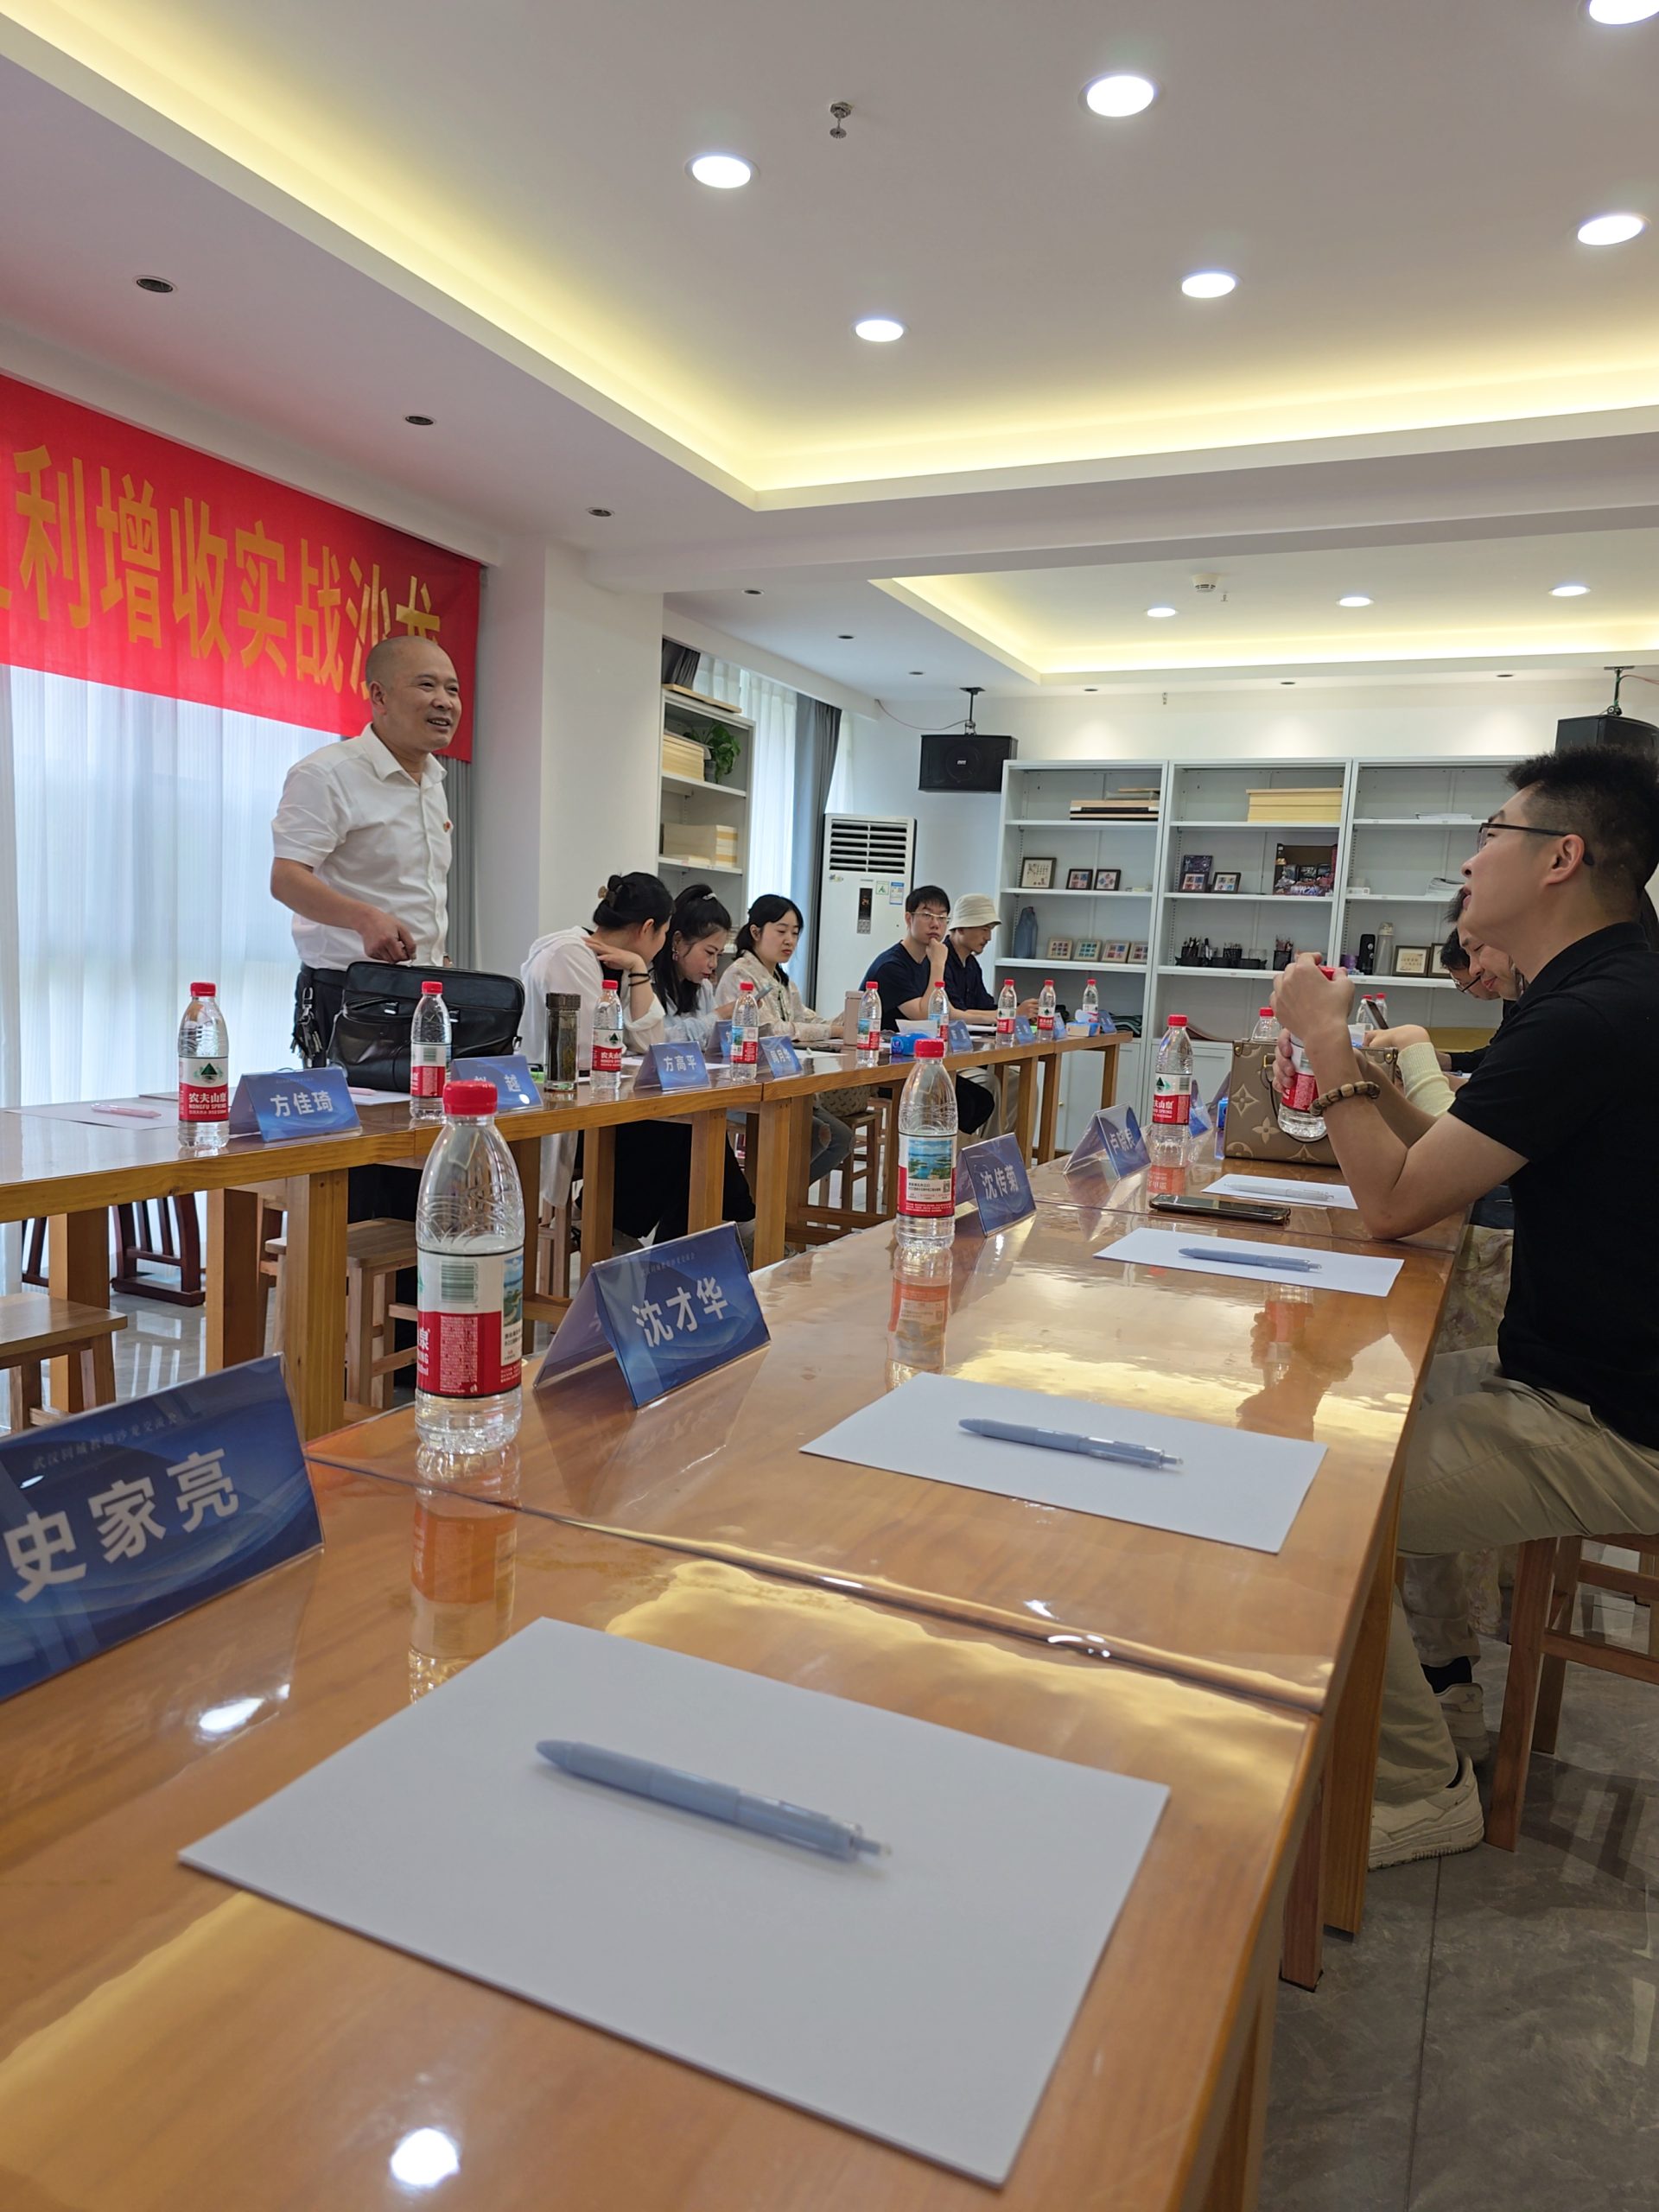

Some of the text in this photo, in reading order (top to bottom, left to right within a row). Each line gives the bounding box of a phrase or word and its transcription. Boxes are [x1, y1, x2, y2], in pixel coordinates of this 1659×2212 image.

[0, 445, 441, 701] 利增收实战沙
[663, 1055, 701, 1071] 方高平
[188, 1092, 226, 1103] 农夫山泉
[270, 1090, 334, 1117] 方佳琦
[632, 1277, 728, 1348] 沈才华
[3, 1448, 239, 1604] 史家亮
